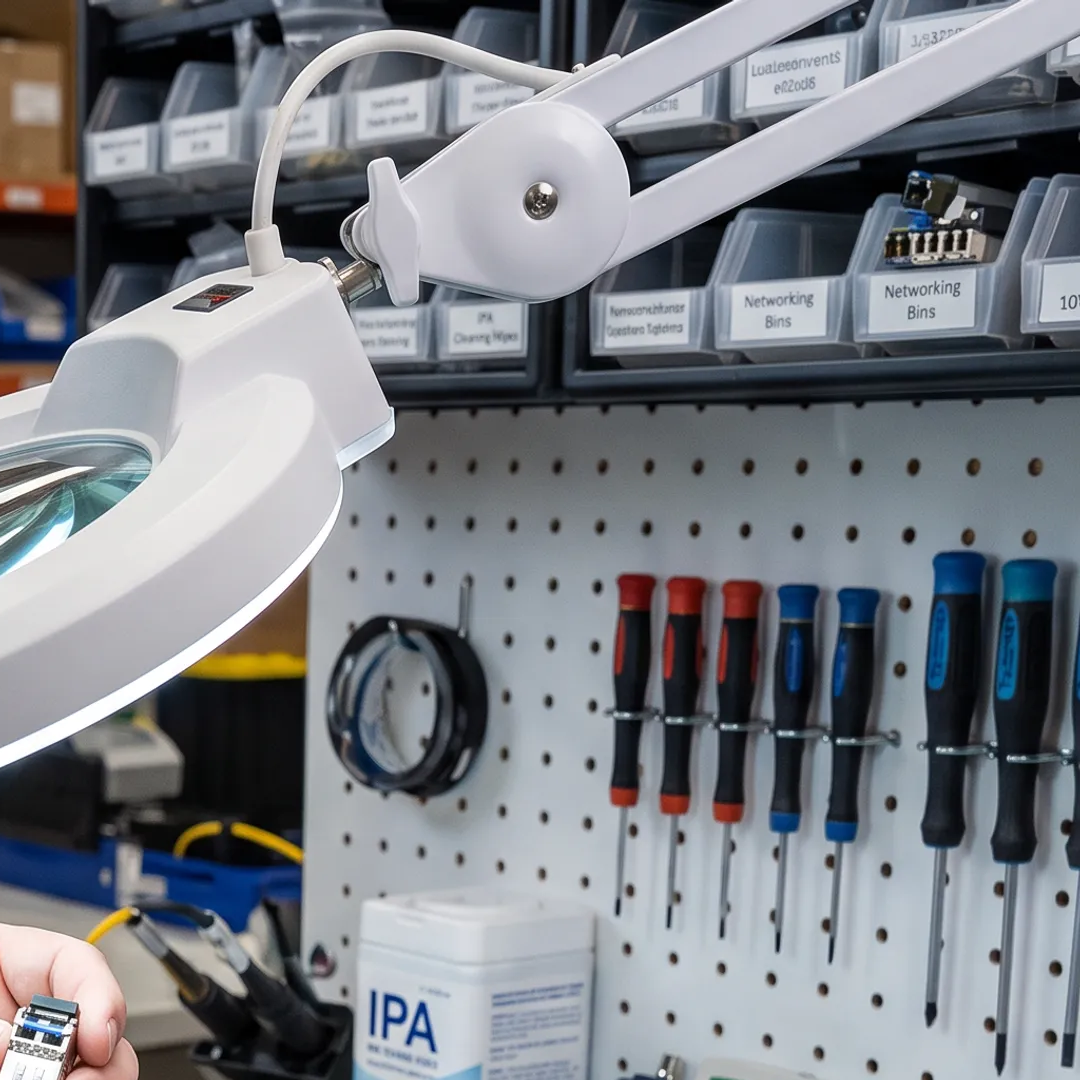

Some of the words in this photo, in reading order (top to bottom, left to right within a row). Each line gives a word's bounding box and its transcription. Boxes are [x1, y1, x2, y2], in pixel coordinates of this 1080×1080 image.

[884, 280, 961, 299] Networking
[744, 292, 814, 309] Networking
[1060, 294, 1080, 311] 10
[907, 305, 936, 320] Bins
[765, 314, 792, 330] Bins
[369, 990, 438, 1054] IPA
